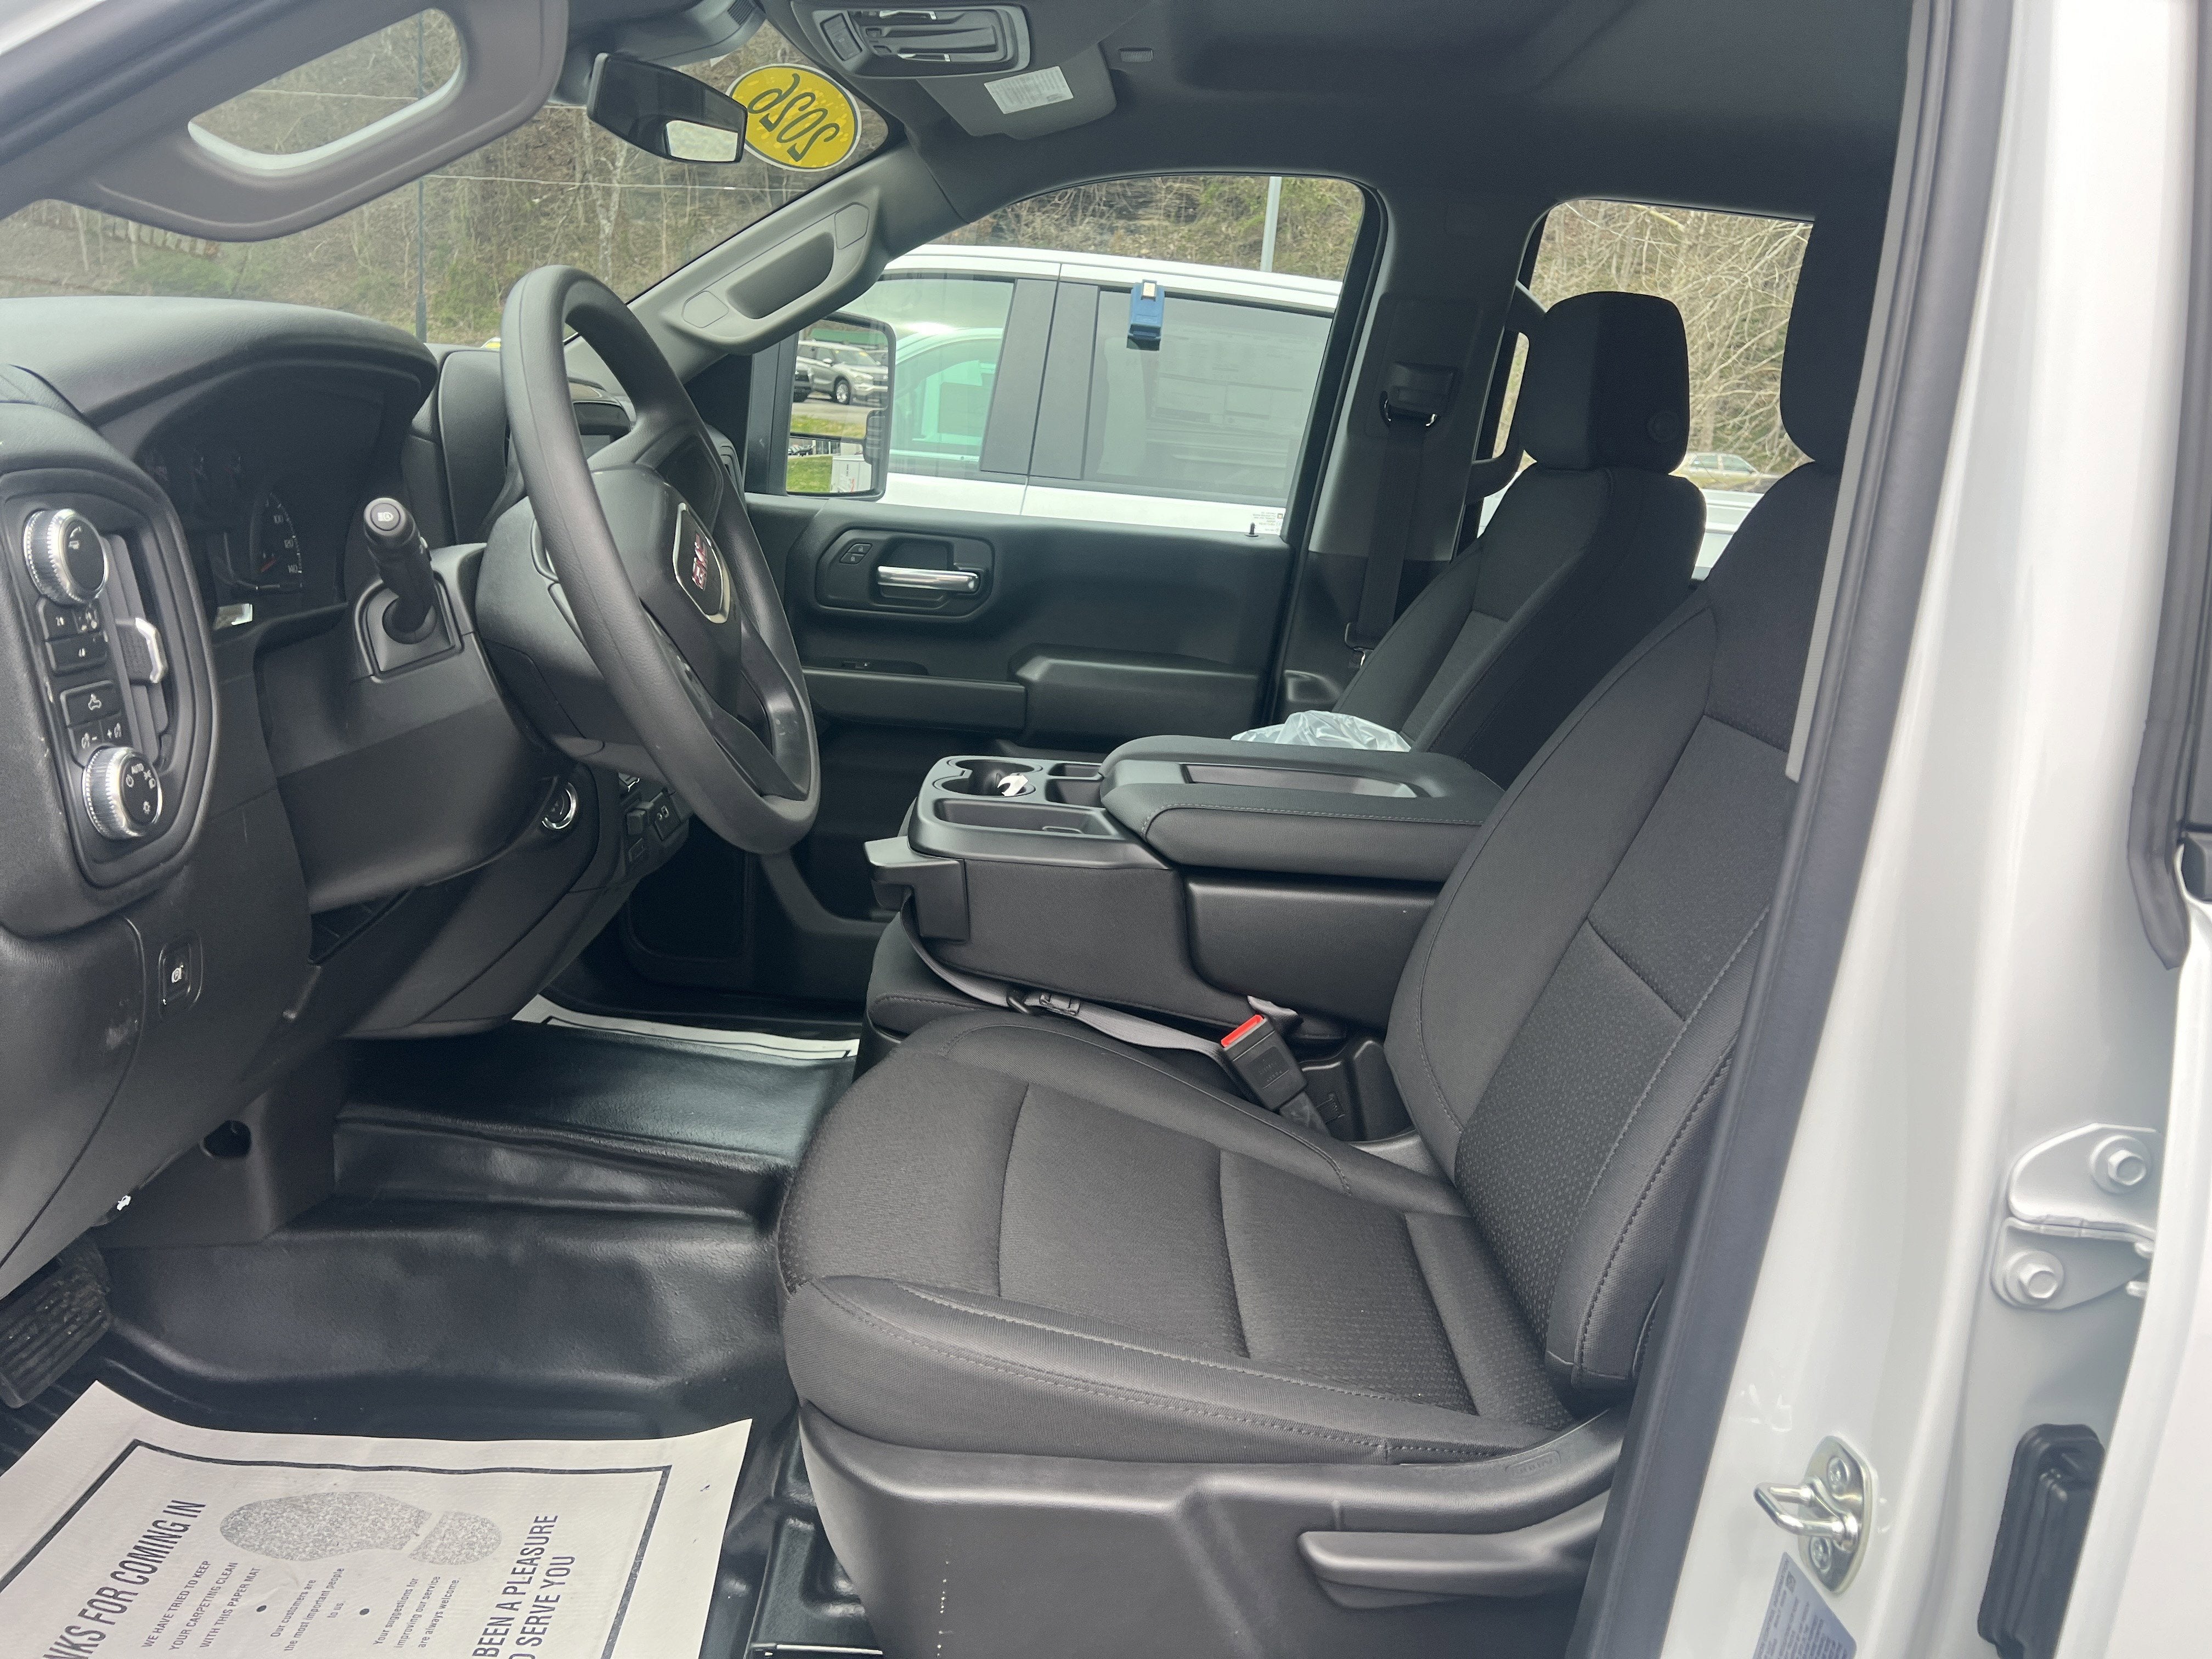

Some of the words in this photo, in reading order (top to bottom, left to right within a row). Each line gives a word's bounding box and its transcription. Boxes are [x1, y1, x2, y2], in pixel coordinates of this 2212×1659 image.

[77, 1586, 139, 1626] FOR
[110, 1520, 191, 1585] COMING
[162, 1499, 206, 1518] IN
[501, 1515, 558, 1595] PLEASURE
[141, 1634, 159, 1647] WE
[155, 1613, 174, 1634] HAVE
[167, 1590, 190, 1612] TRIED
[184, 1579, 199, 1589] TO
[192, 1560, 211, 1578] KEEP
[168, 1629, 193, 1651] YOUR
[186, 1585, 222, 1627] CARPETING
[215, 1562, 239, 1585] CLEAN
[199, 1628, 221, 1649] WITH
[214, 1609, 233, 1626] THIS
[227, 1583, 251, 1607] PAPER
[244, 1567, 262, 1583] MAT
[270, 1624, 286, 1638] Our
[281, 1591, 309, 1623] customers
[304, 1579, 317, 1590] are
[283, 1640, 298, 1651] the
[293, 1622, 311, 1638] most
[302, 1590, 331, 1620] important
[325, 1568, 345, 1589] people
[372, 1629, 390, 1645] Your
[385, 1589, 414, 1629] suggestions
[406, 1577, 419, 1587] for
[393, 1613, 422, 1648] improving
[415, 1601, 427, 1613] our
[422, 1576, 441, 1600] service
[417, 1636, 431, 1648] are
[425, 1611, 444, 1635] always
[438, 1577, 461, 1610] welcome.
[471, 1617, 516, 1658] BEEN
[494, 1600, 522, 1612] A
[515, 1594, 561, 1647] SERVE
[539, 1555, 576, 1590] YOU
